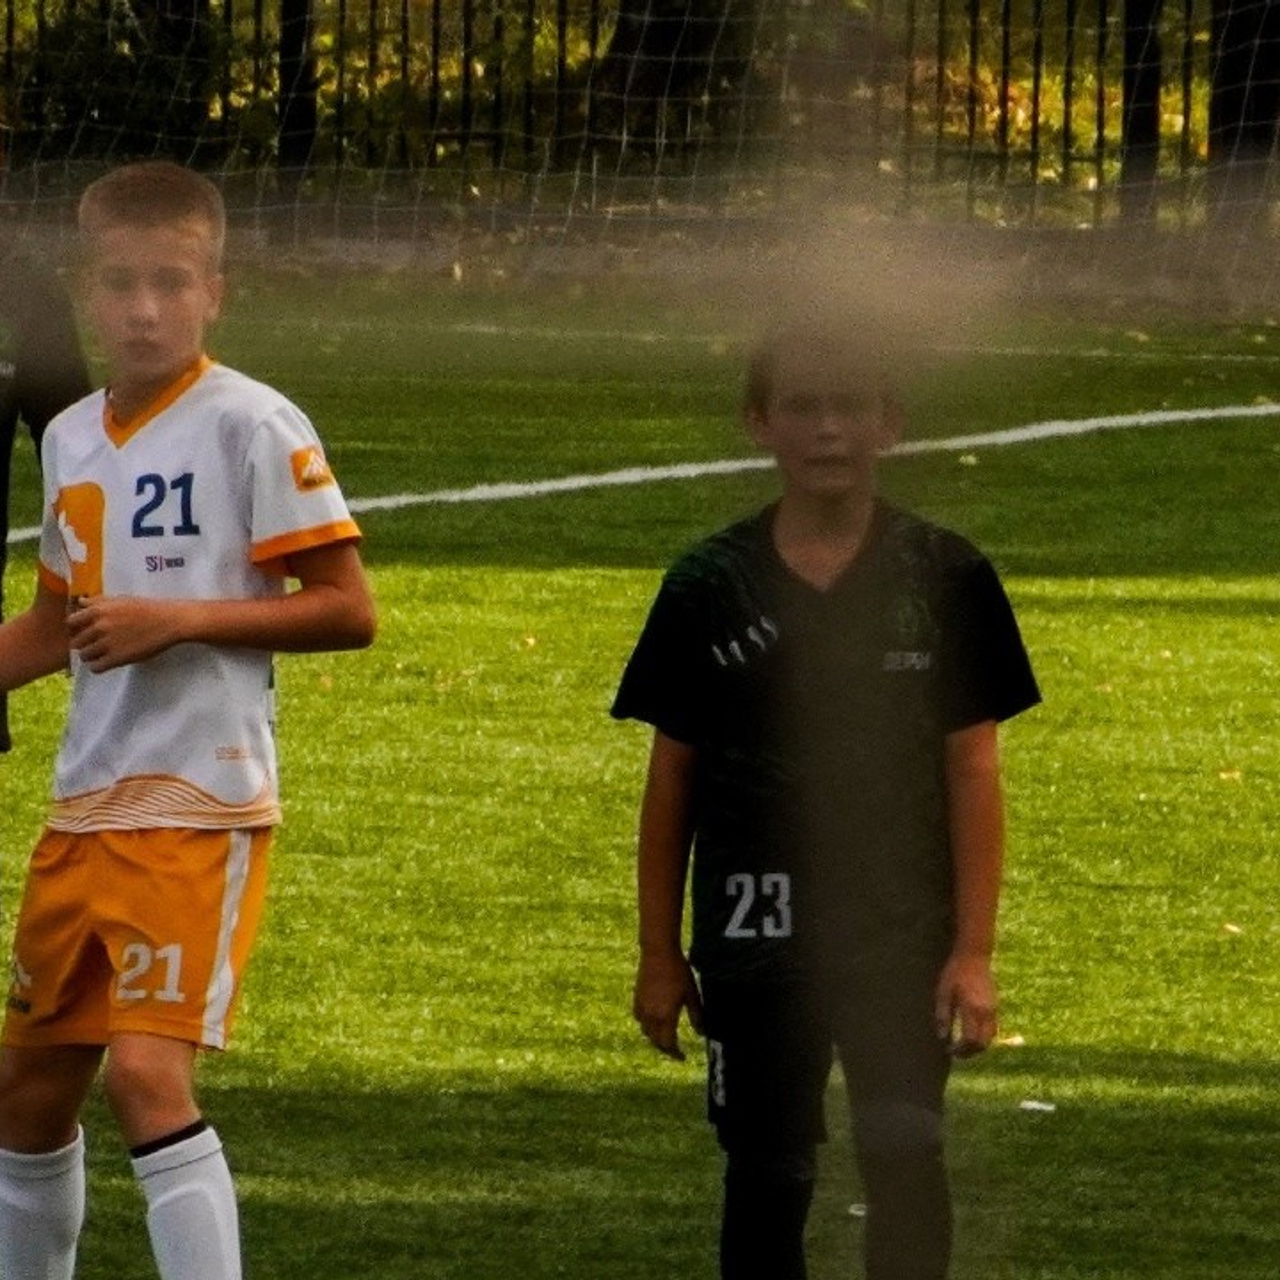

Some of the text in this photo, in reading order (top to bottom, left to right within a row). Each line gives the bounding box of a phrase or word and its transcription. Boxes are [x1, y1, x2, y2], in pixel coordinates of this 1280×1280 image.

[131, 472, 200, 538] 21
[724, 873, 792, 938] 23
[116, 943, 186, 1003] 21
